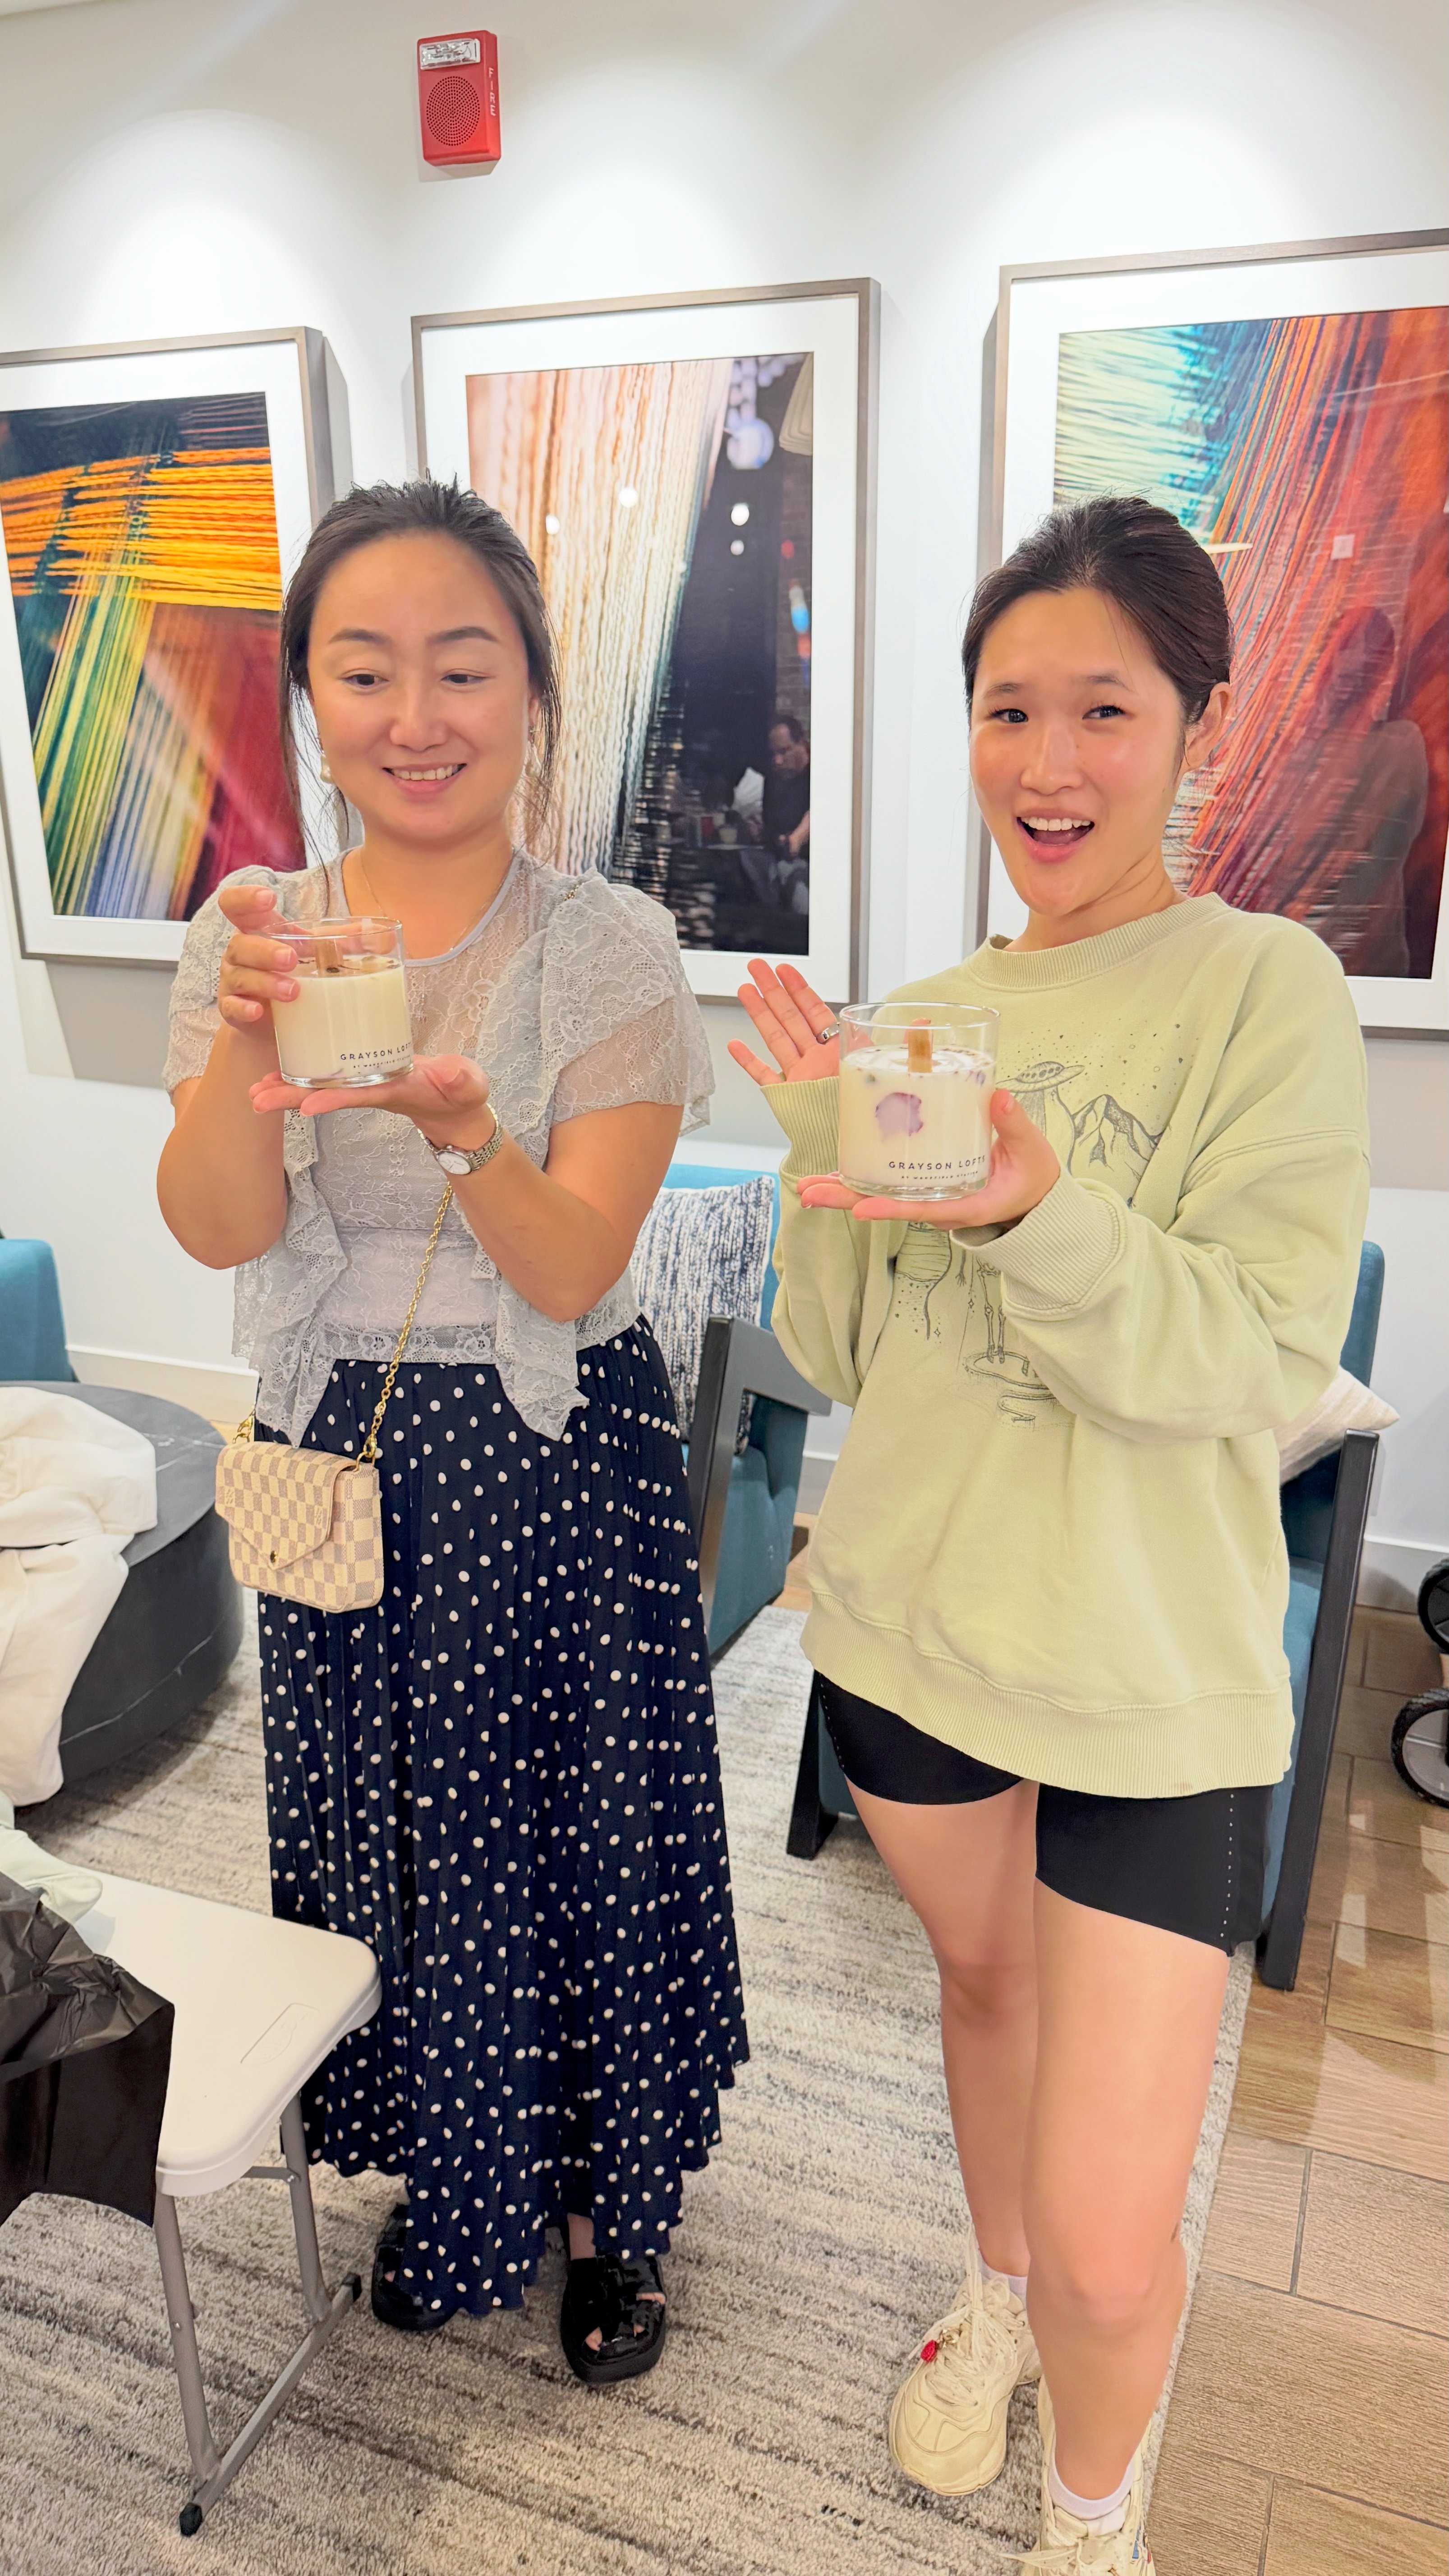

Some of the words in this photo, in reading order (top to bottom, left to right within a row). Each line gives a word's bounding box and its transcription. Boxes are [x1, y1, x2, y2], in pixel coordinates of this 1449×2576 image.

[340, 1049, 392, 1060] GRAYSON
[889, 1161, 952, 1170] GRAYSON
[959, 1155, 985, 1168] LOFTS
